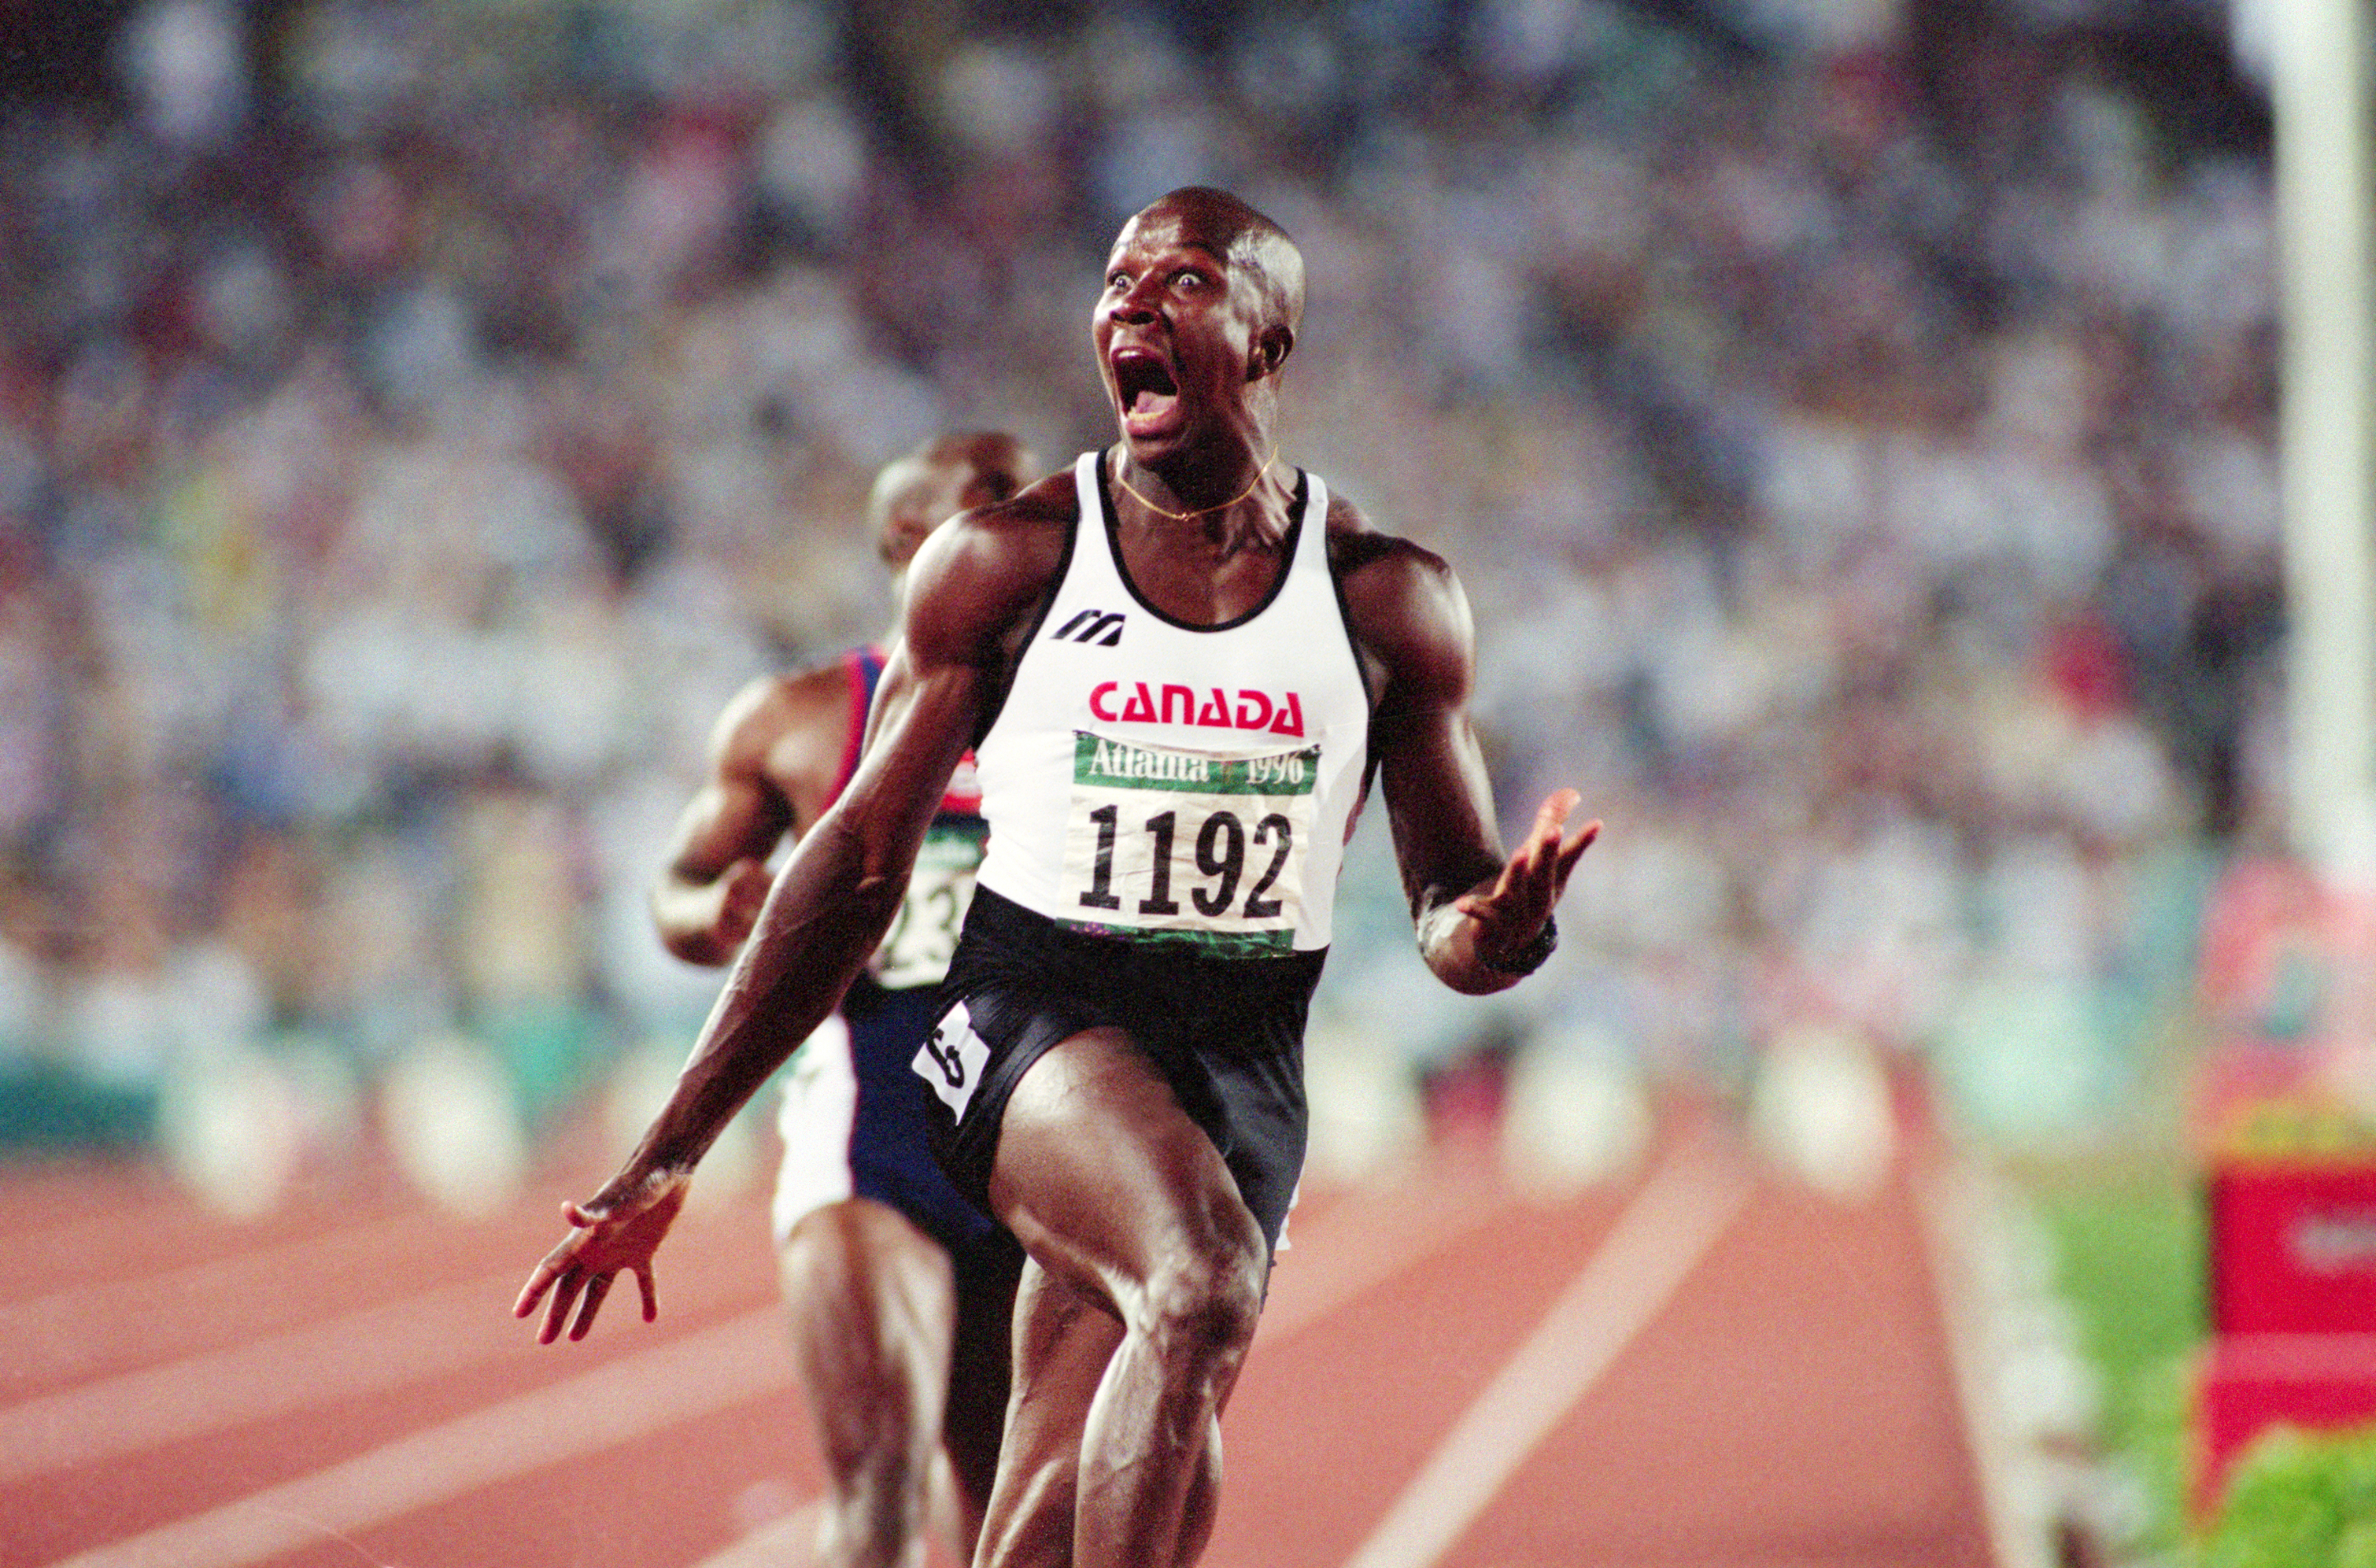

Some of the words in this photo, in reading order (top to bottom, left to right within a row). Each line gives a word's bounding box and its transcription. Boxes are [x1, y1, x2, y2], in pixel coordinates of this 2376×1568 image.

[1089, 681, 1305, 738] CANADA
[1089, 738, 1209, 783] Atlanta
[1246, 754, 1305, 785] 1996
[1080, 804, 1293, 918] 1192
[925, 1028, 965, 1089] 6
